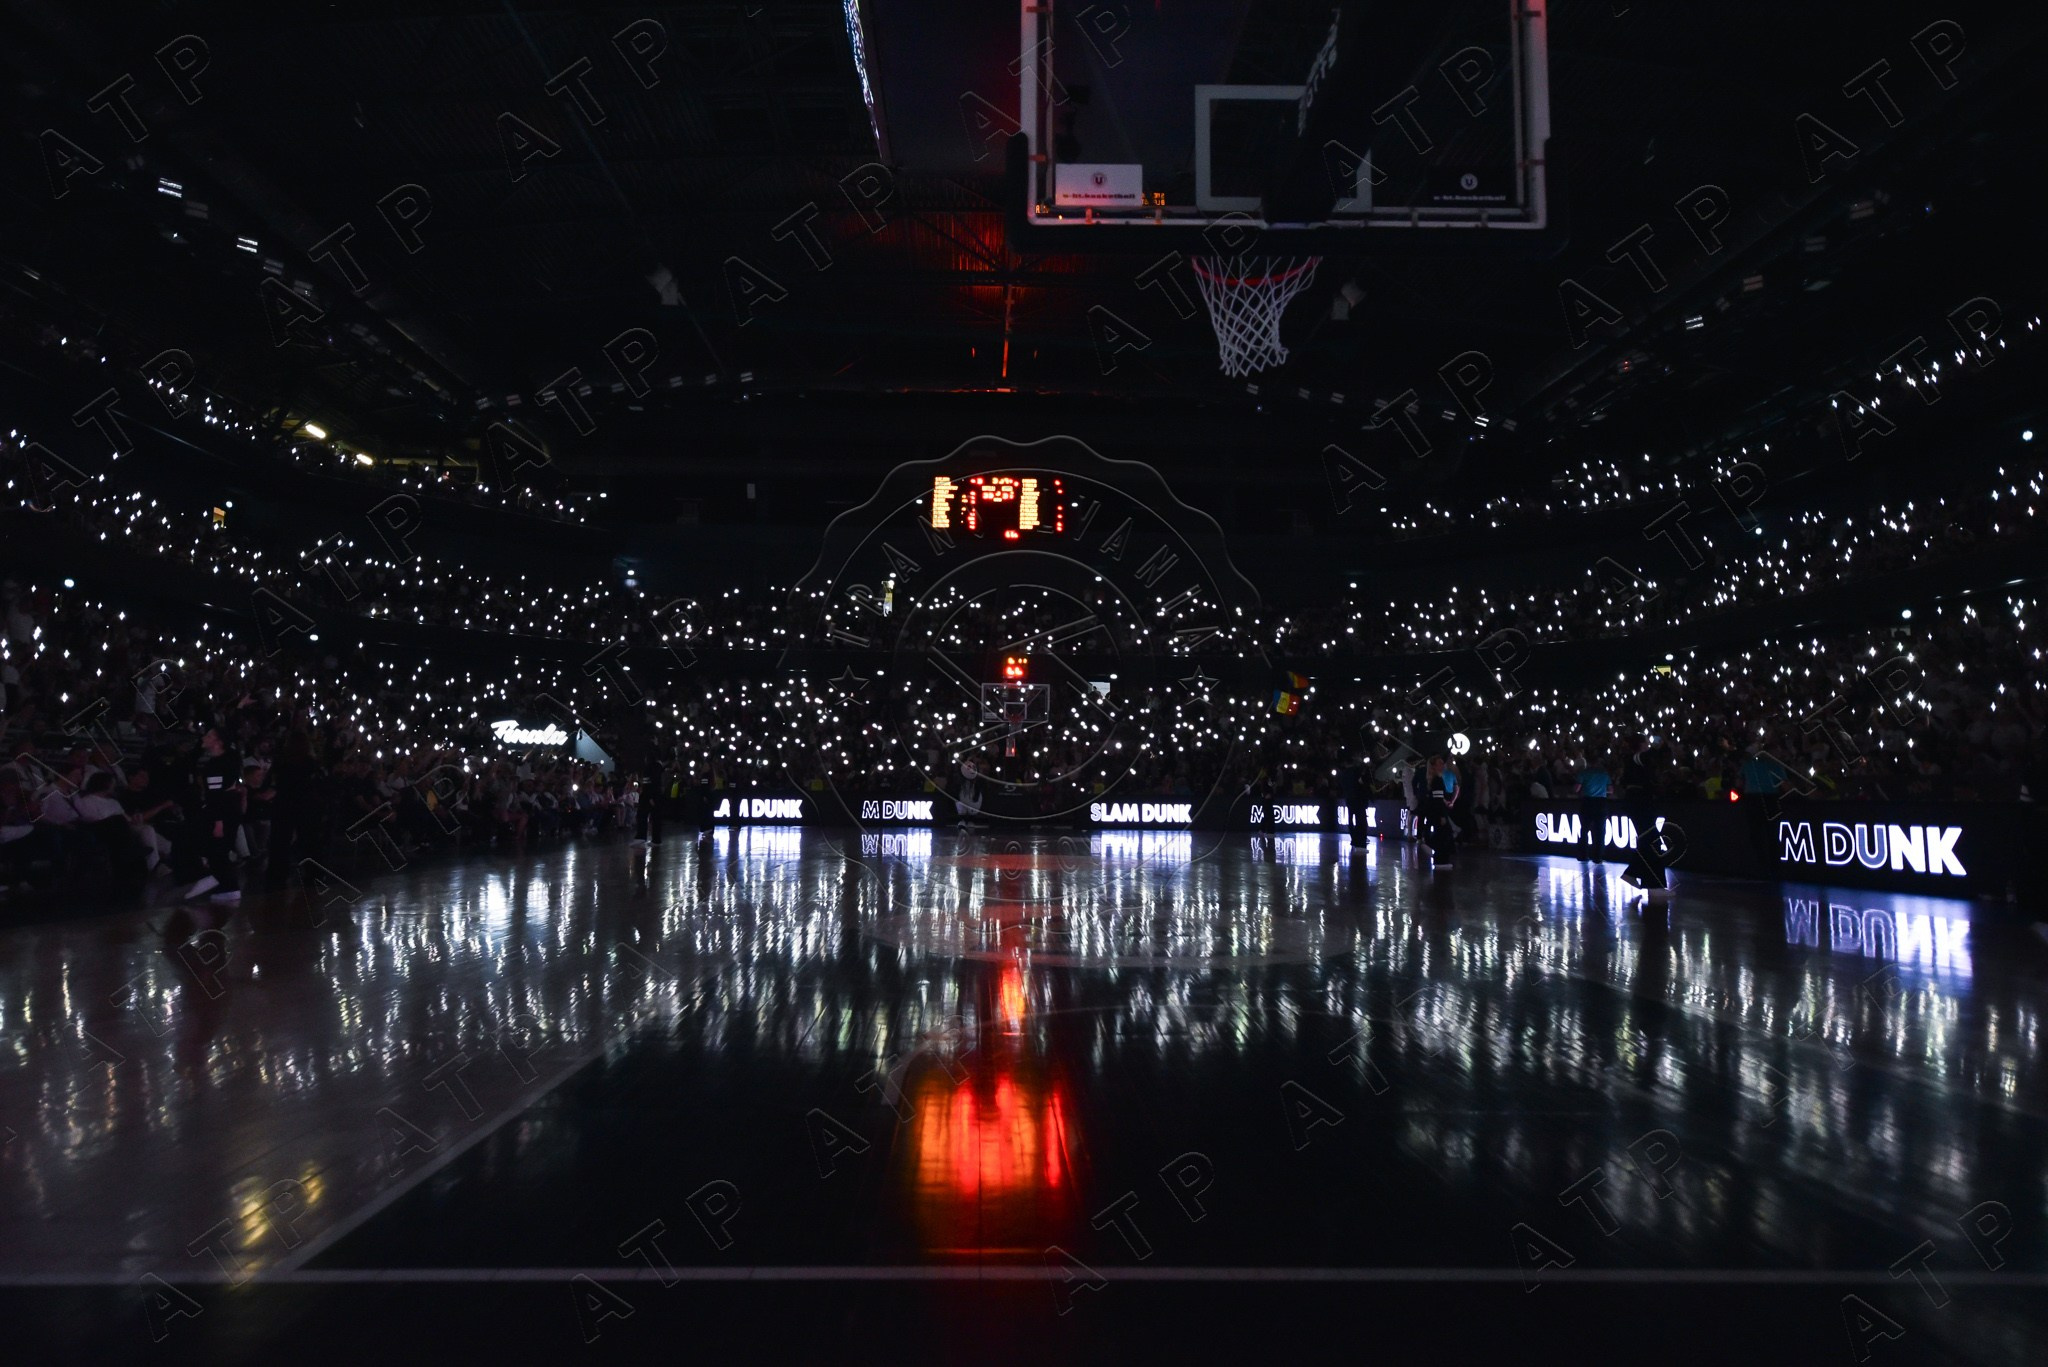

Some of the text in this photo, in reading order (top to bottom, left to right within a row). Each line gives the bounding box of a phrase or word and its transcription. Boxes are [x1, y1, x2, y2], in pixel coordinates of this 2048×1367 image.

[751, 798, 803, 818] DUNK
[861, 800, 933, 820] M DUNK
[1090, 802, 1193, 823] SLAM DUNK
[1272, 804, 1321, 824] DUNK
[1778, 821, 1968, 876] M DUNK
